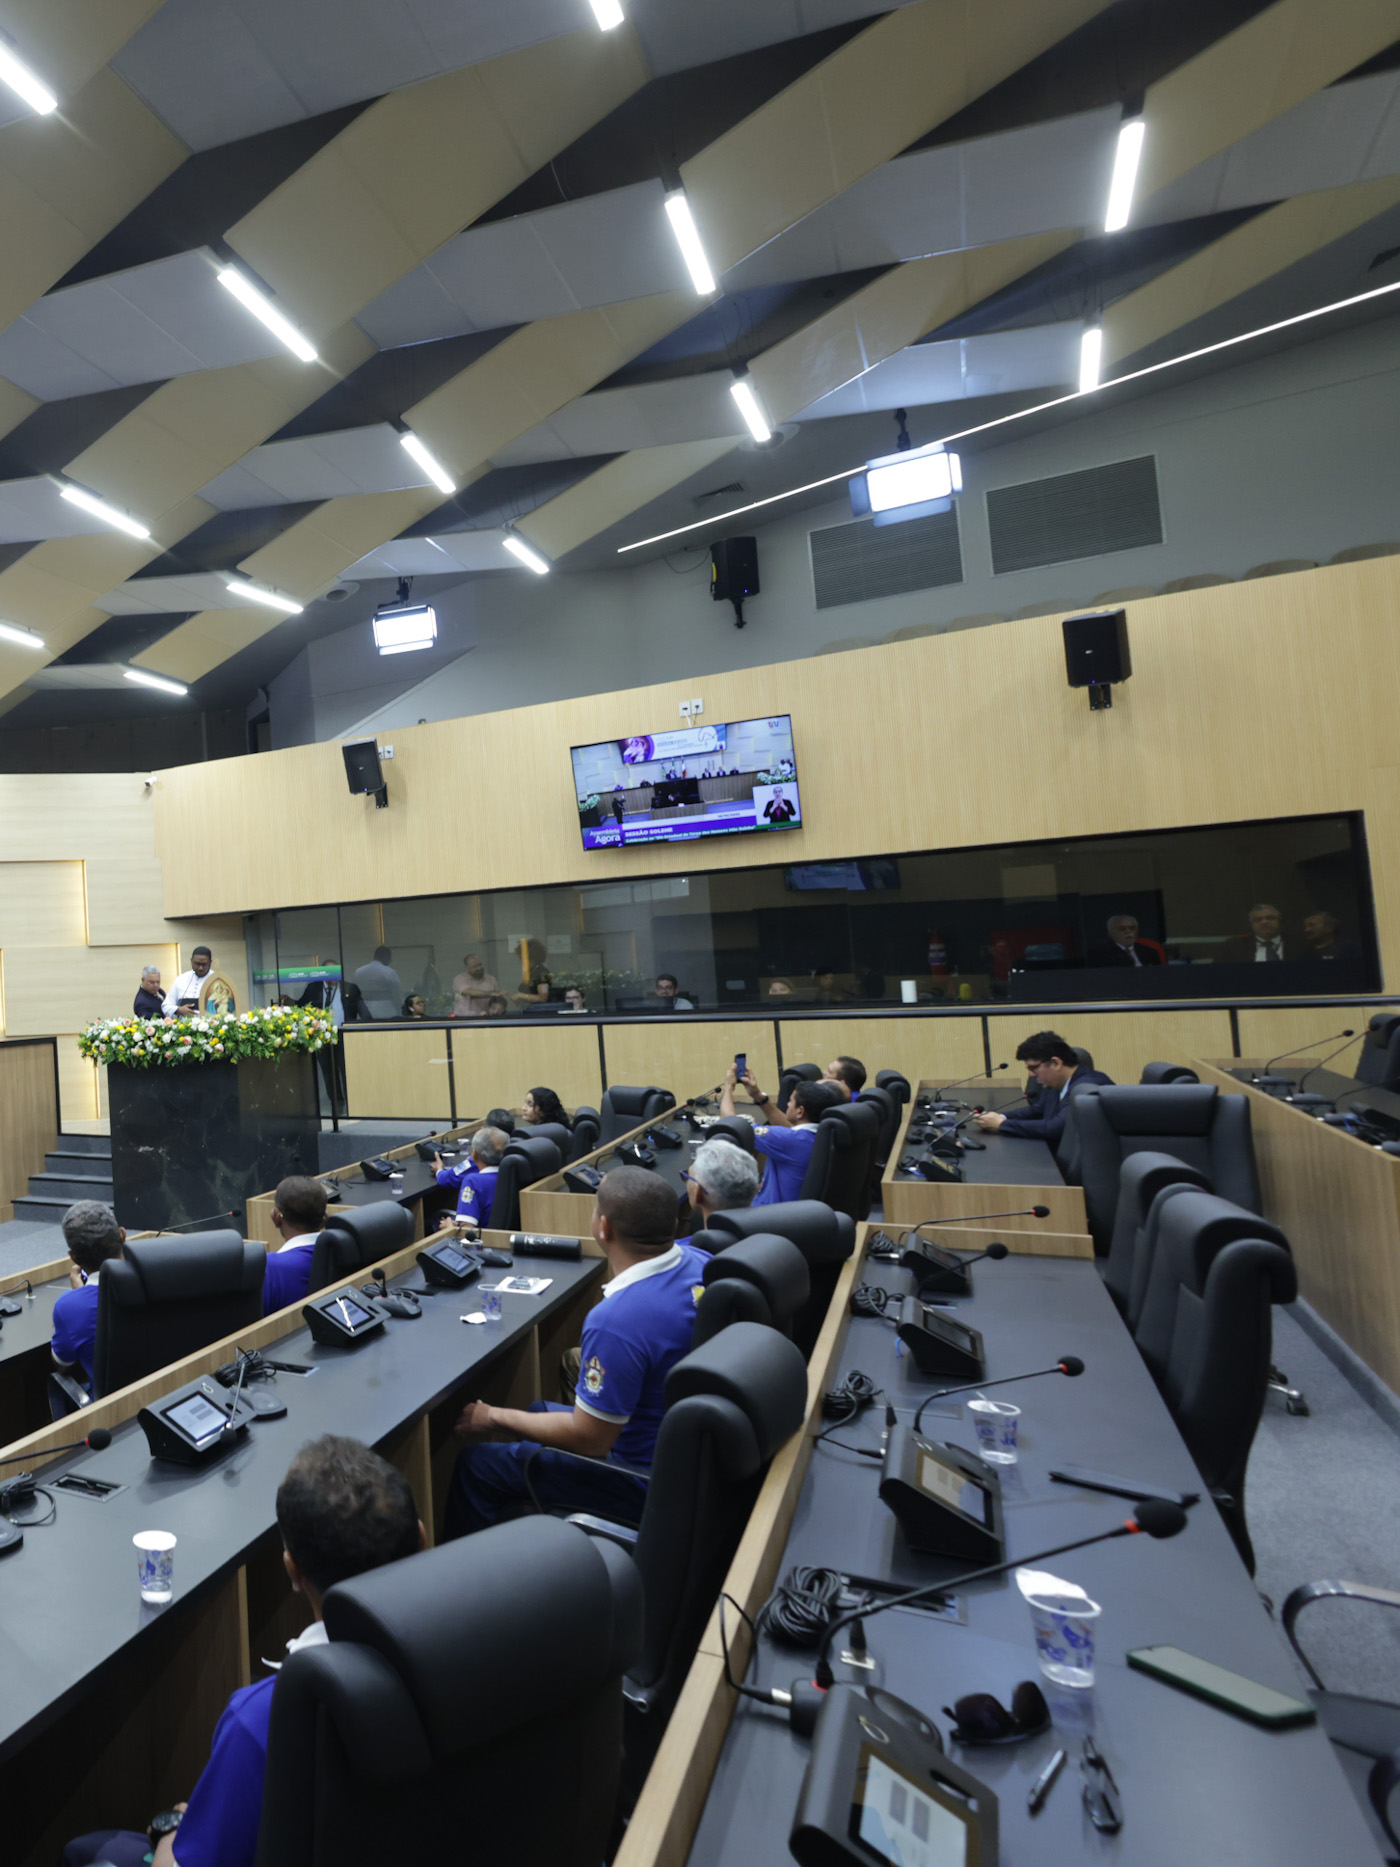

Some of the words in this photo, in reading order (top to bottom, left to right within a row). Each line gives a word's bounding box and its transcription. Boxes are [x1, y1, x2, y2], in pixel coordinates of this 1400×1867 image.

[625, 829, 648, 837] SESSÃO
[650, 827, 673, 835] SOLENE
[595, 834, 621, 845] Agora
